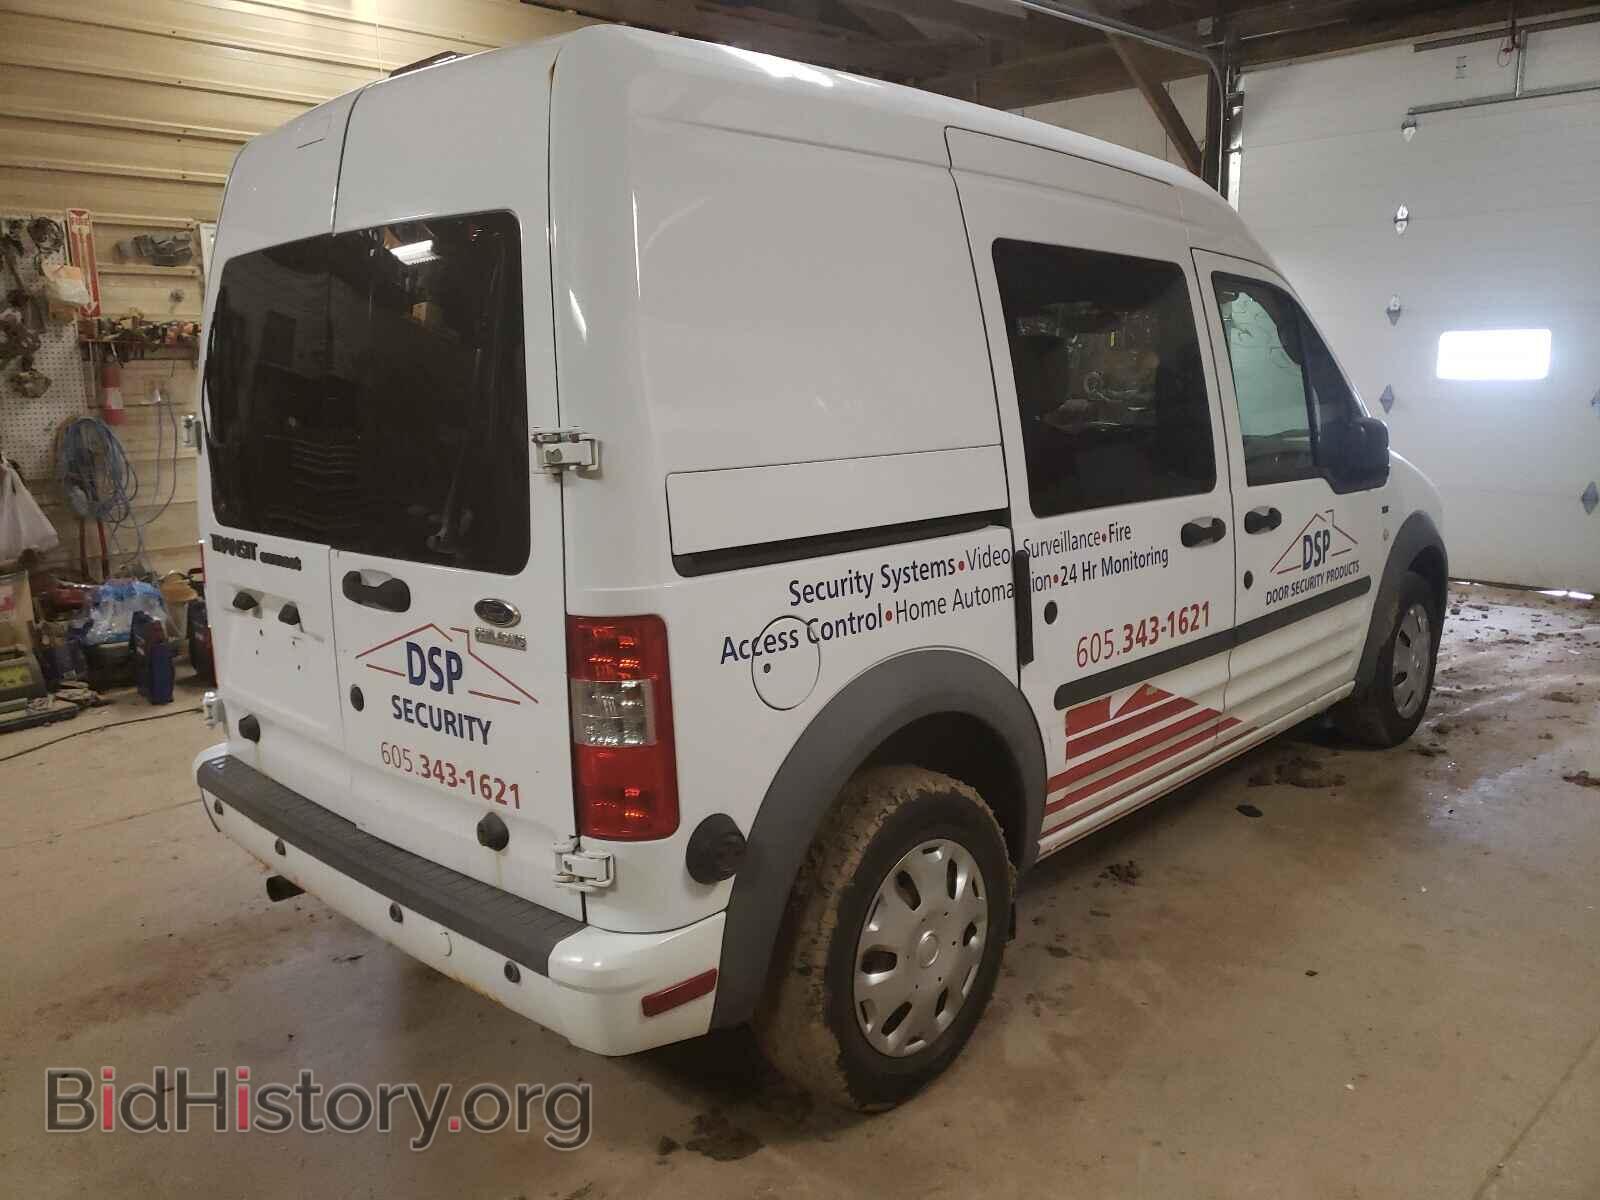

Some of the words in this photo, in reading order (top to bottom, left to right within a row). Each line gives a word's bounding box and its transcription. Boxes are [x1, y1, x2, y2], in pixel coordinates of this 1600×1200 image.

[788, 569, 874, 607] Security
[880, 557, 956, 593] Systems
[965, 544, 1011, 571] Video
[1023, 530, 1101, 559] Surveillance
[1108, 521, 1132, 544] Fire
[1302, 529, 1331, 571] DSP
[720, 629, 799, 665] Access
[806, 603, 883, 644] Control
[895, 597, 947, 624] Home
[952, 571, 1052, 612] Automaion
[1060, 563, 1078, 587] 24
[1082, 562, 1098, 582] Hr
[1101, 546, 1169, 578] Monitoring
[1265, 585, 1289, 606] DOOR
[1291, 571, 1325, 597] SECURITY
[1326, 560, 1360, 584] PRODUCTS
[1076, 600, 1210, 669] 605.343-1621
[406, 641, 464, 695] DSP
[391, 694, 492, 746] SECURITY
[380, 741, 521, 810] 605.343-1621
